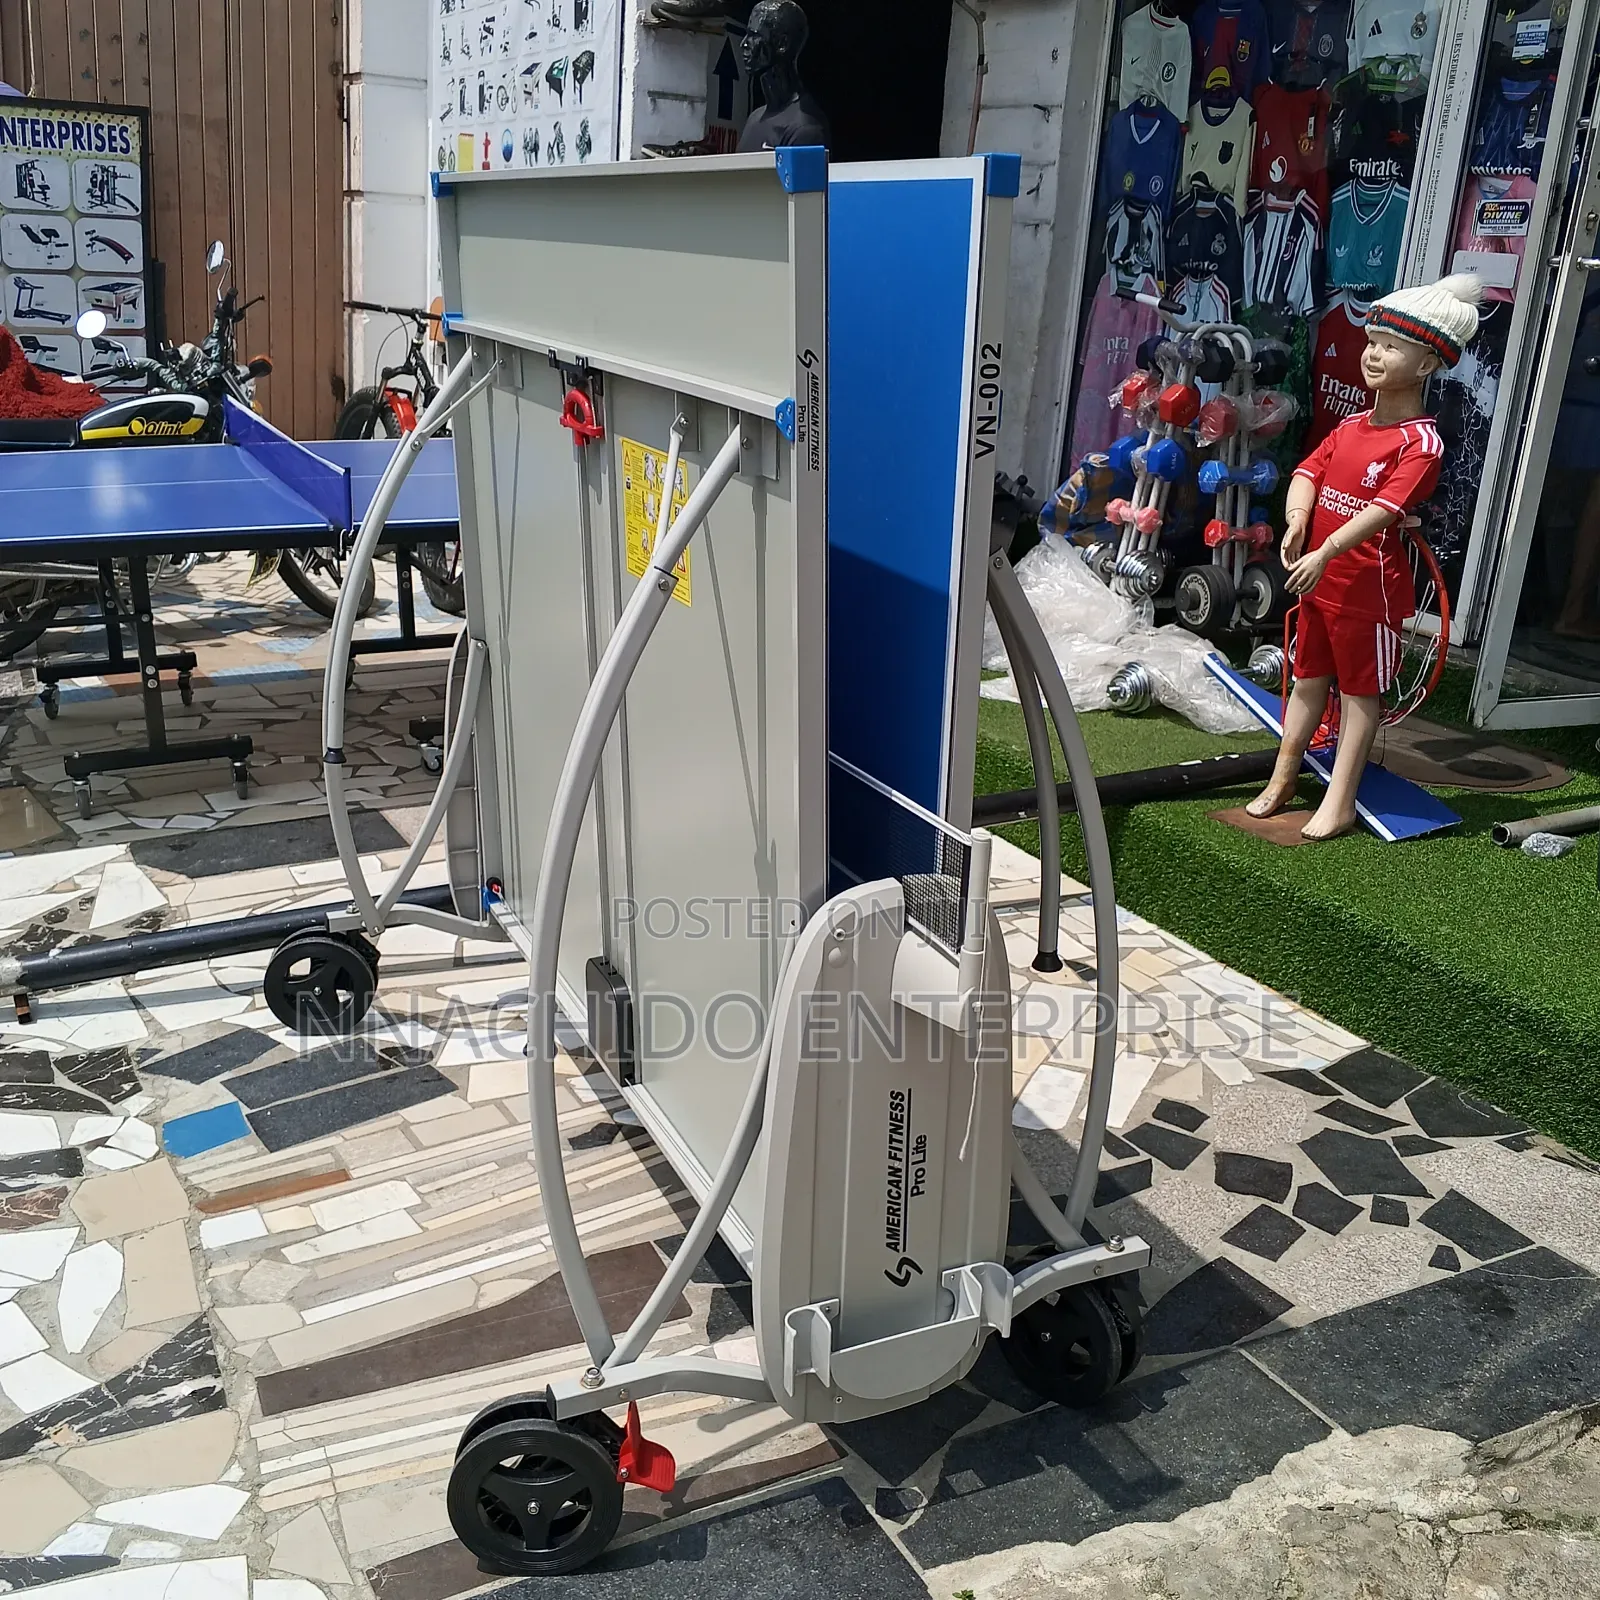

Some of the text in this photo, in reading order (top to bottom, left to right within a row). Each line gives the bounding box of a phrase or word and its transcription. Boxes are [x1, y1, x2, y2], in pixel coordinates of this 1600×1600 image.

[1440, 93, 1452, 130] SUPREME
[0, 115, 131, 155] NTERPRISES
[1435, 132, 1445, 159] quality
[1349, 157, 1404, 178] Emirate
[1483, 211, 1523, 219] DIVINE
[975, 343, 1002, 460] VN-002
[145, 421, 183, 435] Qlink
[798, 405, 806, 443] Pro Lite
[810, 372, 819, 471] AMERICAN FITNESS
[1318, 496, 1361, 519] chartere
[1322, 485, 1372, 510] standard
[885, 1090, 905, 1254] AMERICAN FITNESS
[910, 1134, 927, 1198] Pro Lite
